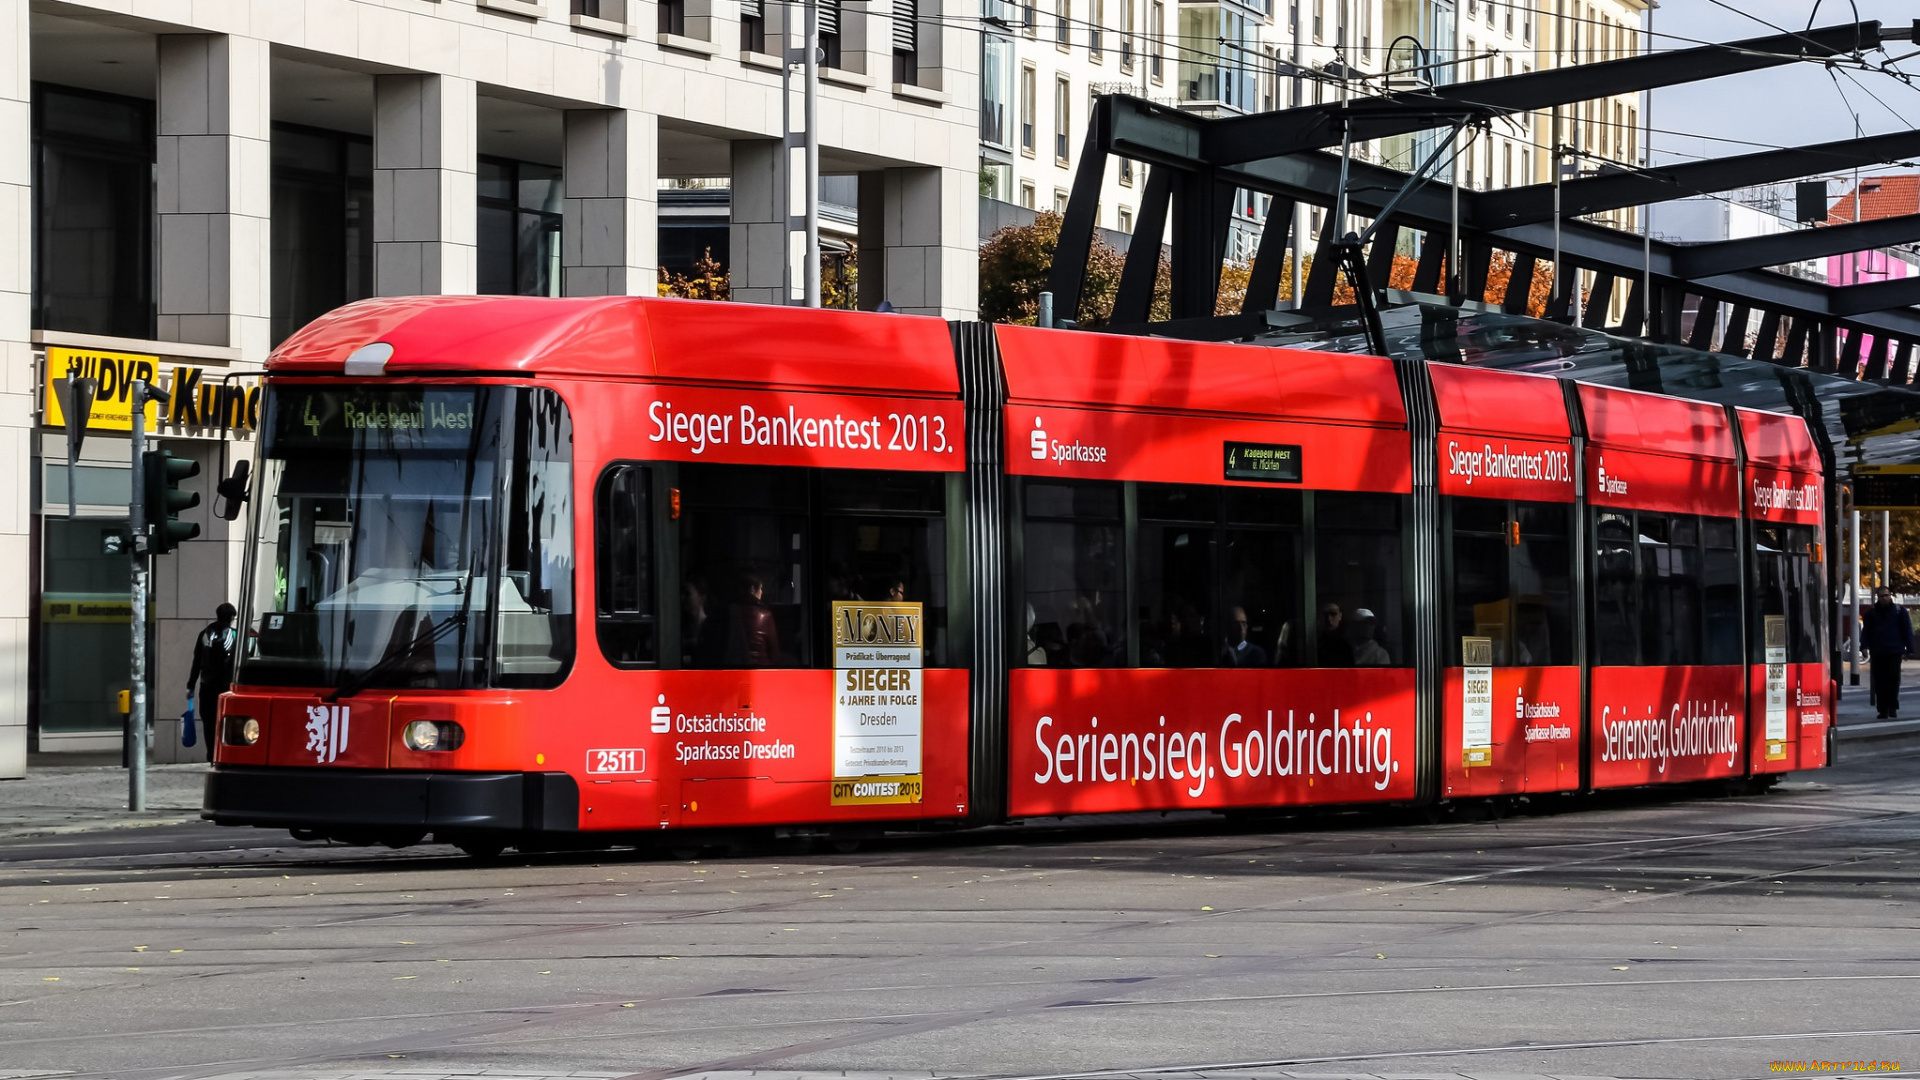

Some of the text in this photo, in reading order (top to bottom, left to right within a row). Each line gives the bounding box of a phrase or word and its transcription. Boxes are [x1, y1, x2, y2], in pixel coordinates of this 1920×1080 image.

[303, 395, 474, 436] 4 Radebeul West
[648, 400, 954, 454] Sieger Bankentest 2013.
[1051, 440, 1107, 466] Sparkasse
[1228, 447, 1236, 469] 4
[1448, 441, 1572, 485] Sieger Bankentest 2013.
[1606, 475, 1628, 498] Sparkasse
[1753, 478, 1772, 516] Sieger
[1772, 480, 1804, 511] Bankentest
[843, 608, 919, 644] MONEY
[846, 669, 911, 692] SIEGER
[1467, 680, 1489, 694] SIEGER
[839, 694, 917, 706] 4 JAHRE IN FOLGE
[1525, 702, 1560, 718] Ostsächsische
[676, 712, 766, 733] Ostsächsische
[860, 712, 897, 726] Dresden
[1525, 723, 1571, 743] Sparkasse Dresden
[1602, 699, 1738, 773] Seriensieg. Goldrichtig.
[597, 751, 635, 771] 2511
[675, 739, 795, 765] Sparkasse Dresden
[1034, 709, 1399, 798] Seriensieg. Goldrichtig.
